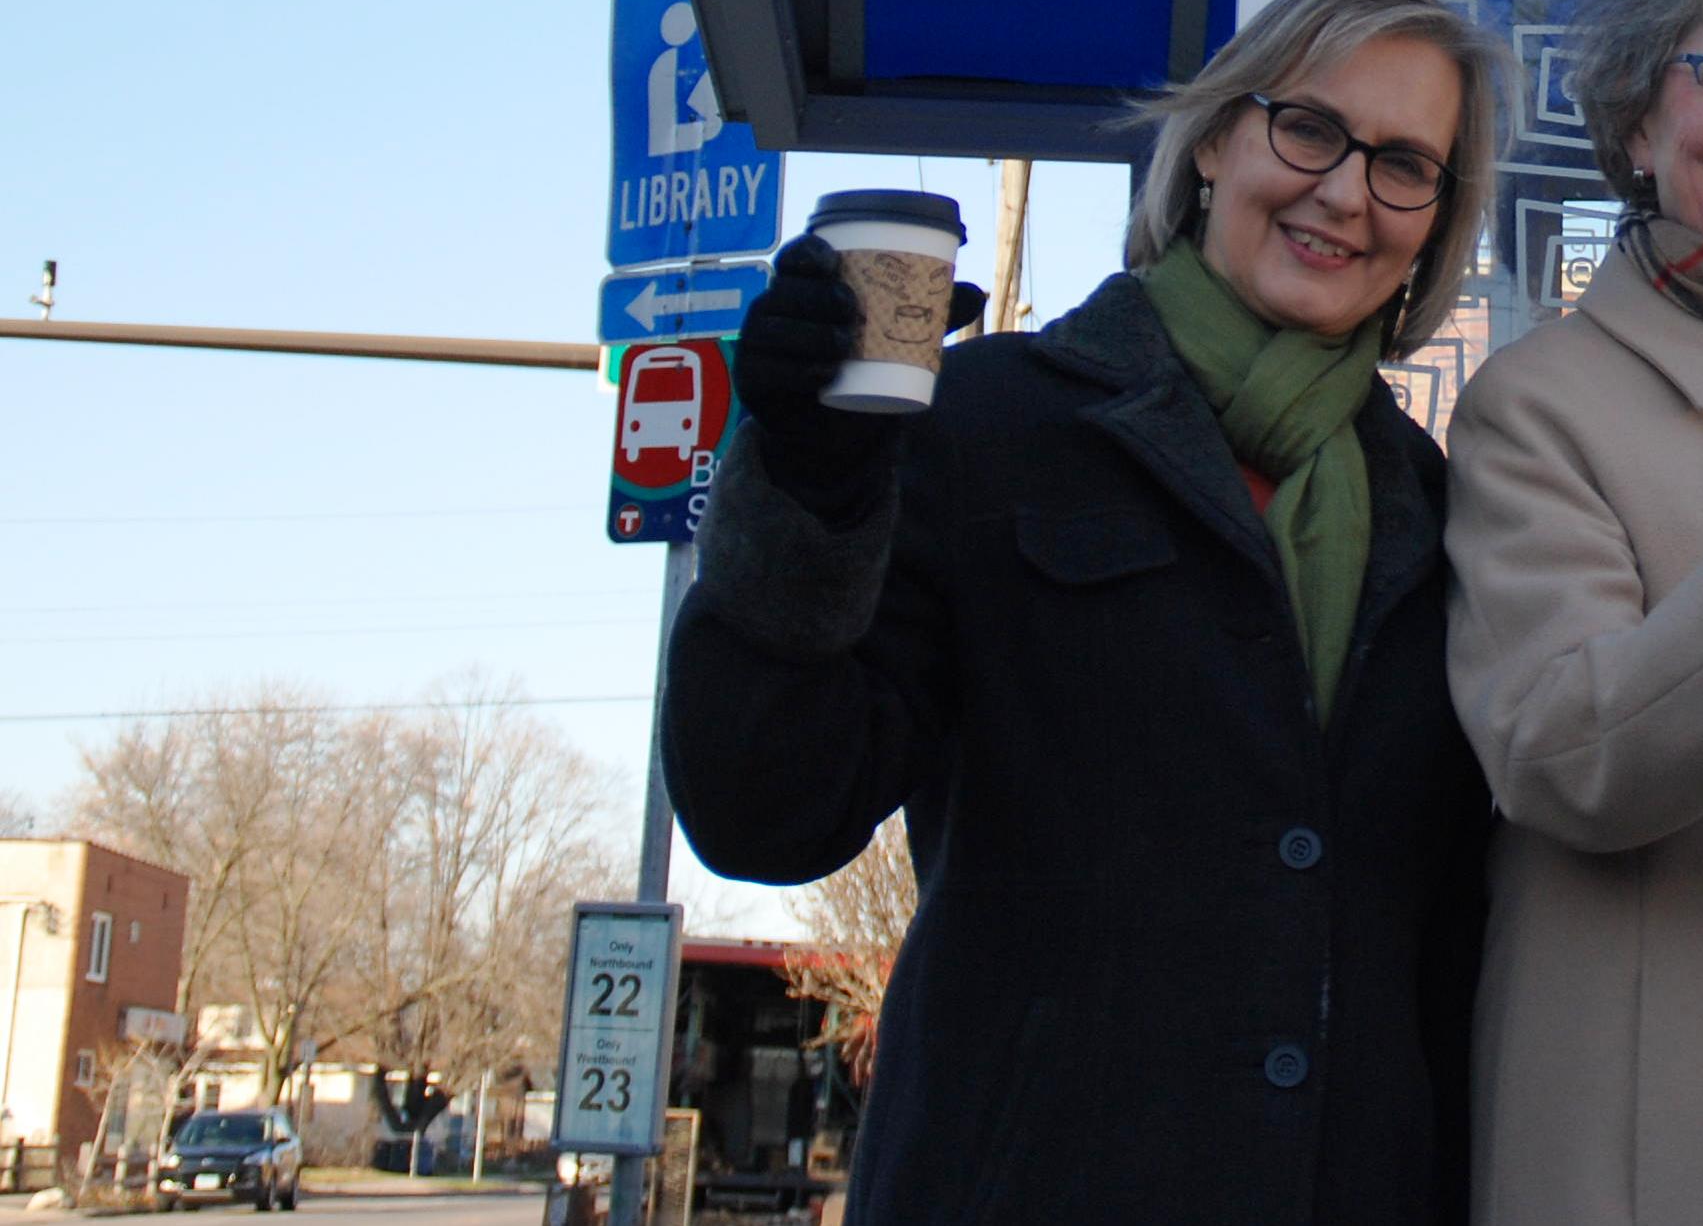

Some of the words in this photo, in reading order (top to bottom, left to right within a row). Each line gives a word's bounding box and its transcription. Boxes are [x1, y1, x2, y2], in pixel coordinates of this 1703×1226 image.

[619, 162, 767, 231] LIBRARY
[608, 941, 634, 954] Only
[589, 957, 653, 971] Northbound
[588, 973, 641, 1017] 22
[596, 1037, 621, 1052] Only
[578, 1068, 631, 1113] 23
